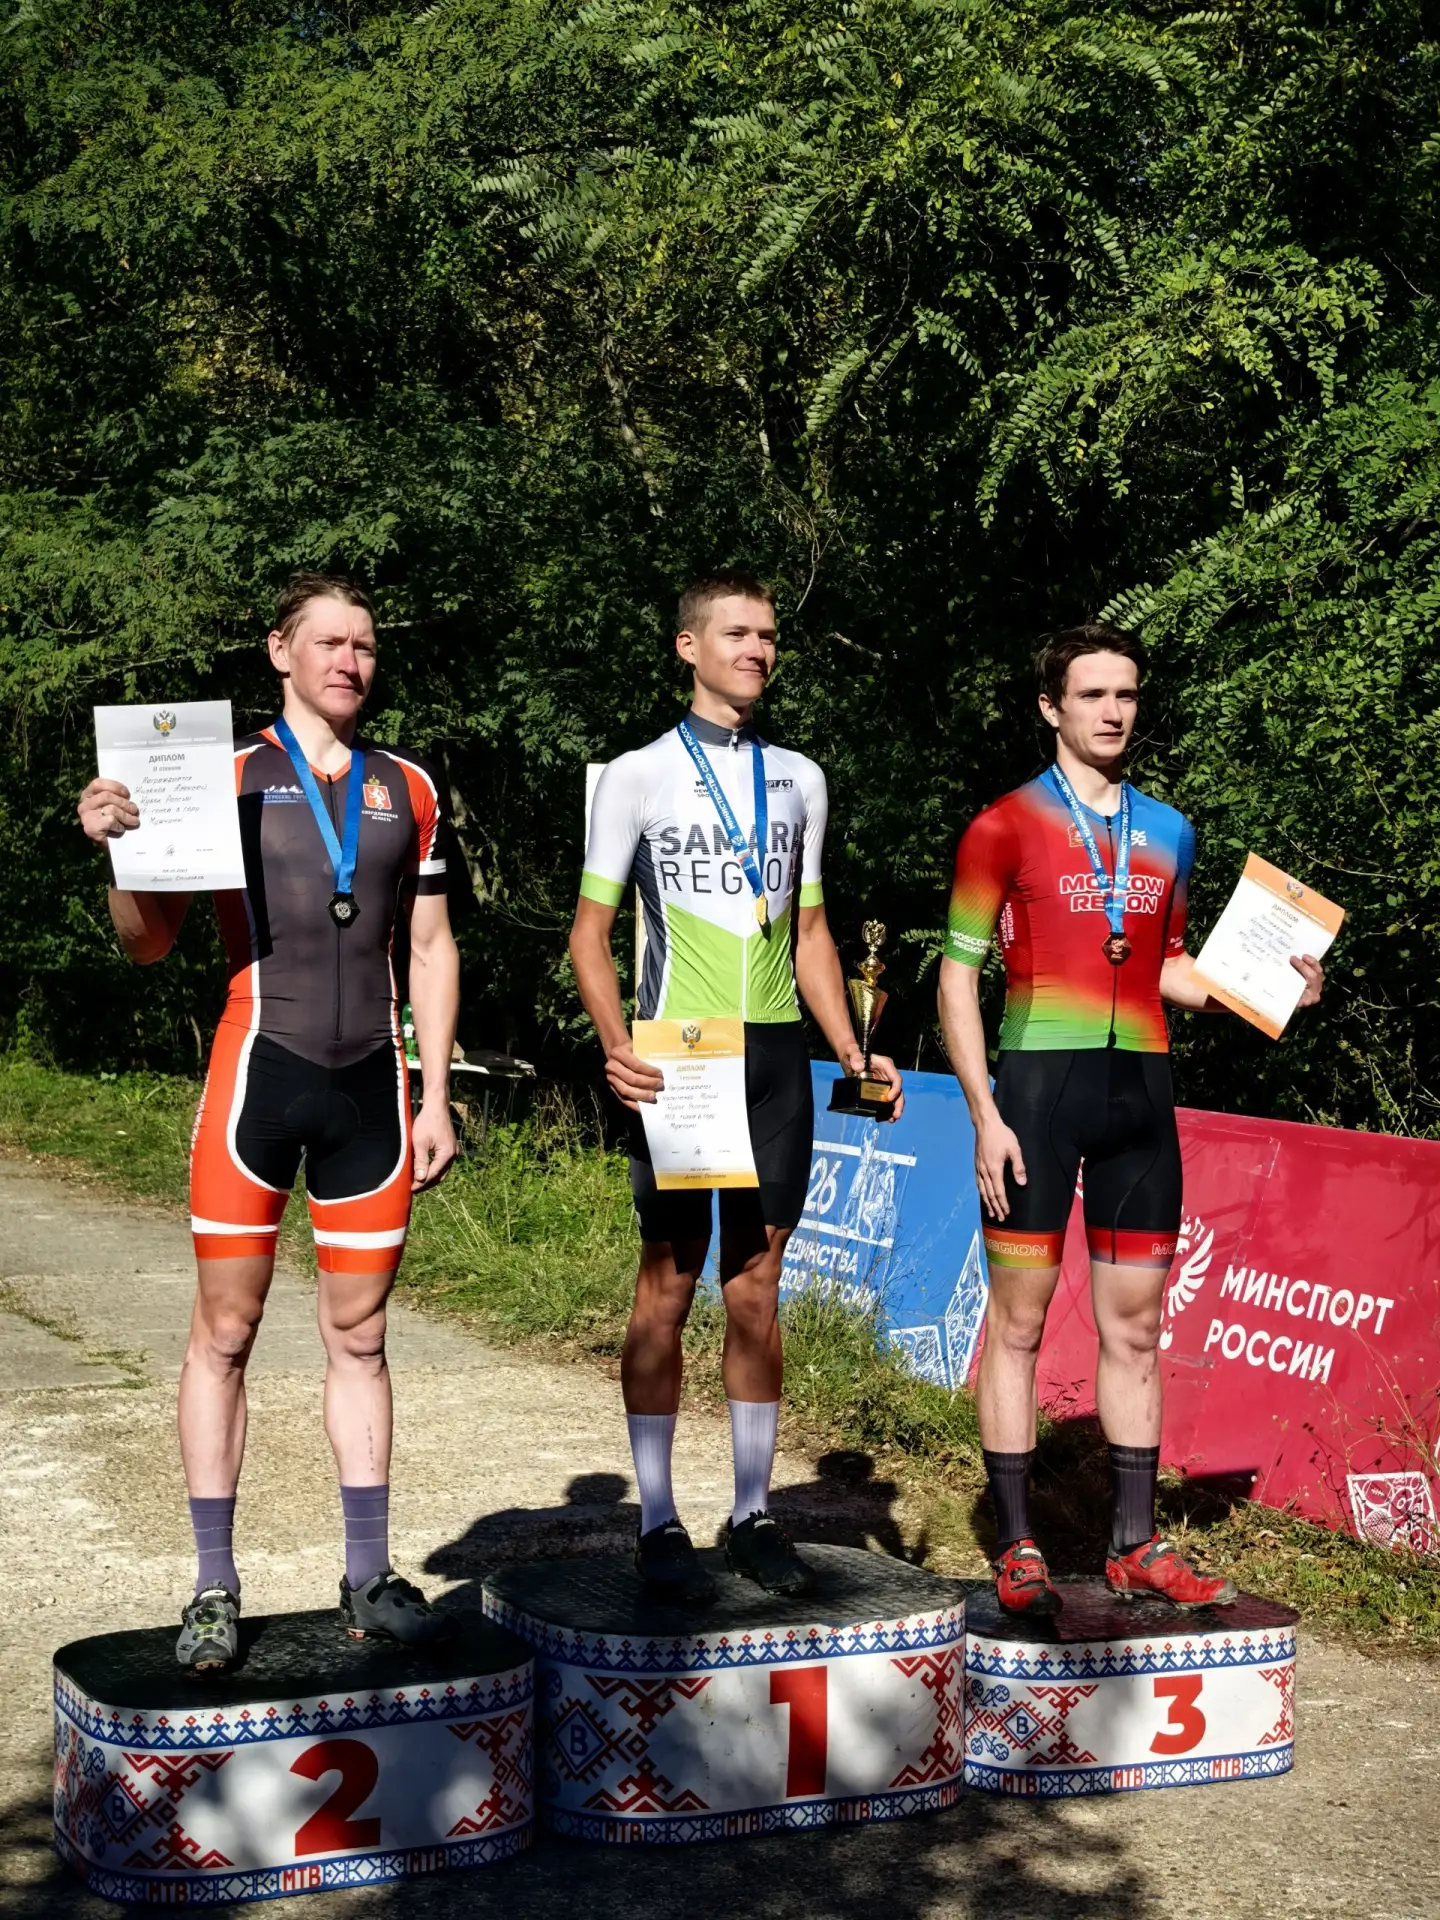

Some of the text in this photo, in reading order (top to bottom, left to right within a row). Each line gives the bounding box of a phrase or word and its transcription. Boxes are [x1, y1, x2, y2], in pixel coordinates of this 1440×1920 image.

[148, 753, 186, 764] ДИПЛОМ
[691, 746, 709, 773] СПОРТА
[705, 773, 736, 831] МИНИСТЕРСТВО
[1075, 810, 1091, 838] СПОРТА
[1087, 838, 1102, 869] РОССИИ
[1060, 873, 1165, 896] MOOW
[1071, 893, 1158, 914] REON
[1006, 902, 1016, 941] REGION
[949, 929, 990, 948] MOSCOW
[803, 1156, 842, 1215] 26
[783, 1236, 859, 1276] ЕДИНСТВА
[778, 1266, 807, 1292] ДОВ
[1219, 1264, 1395, 1335] МИНСПОРТ
[1203, 1318, 1336, 1384] РОССИИ
[1149, 1674, 1207, 1755] 3
[769, 1665, 828, 1798] 1
[1113, 1768, 1144, 1788] MTB
[1212, 1758, 1242, 1777] MTB
[1002, 1773, 1038, 1794] MTB
[288, 1738, 381, 1858] 2
[838, 1801, 871, 1820] MTB
[604, 1822, 644, 1843] MTB
[724, 1813, 761, 1836] MTB
[409, 1849, 448, 1872] MTB
[282, 1865, 322, 1890] MTB
[147, 1881, 189, 1904] MTB
